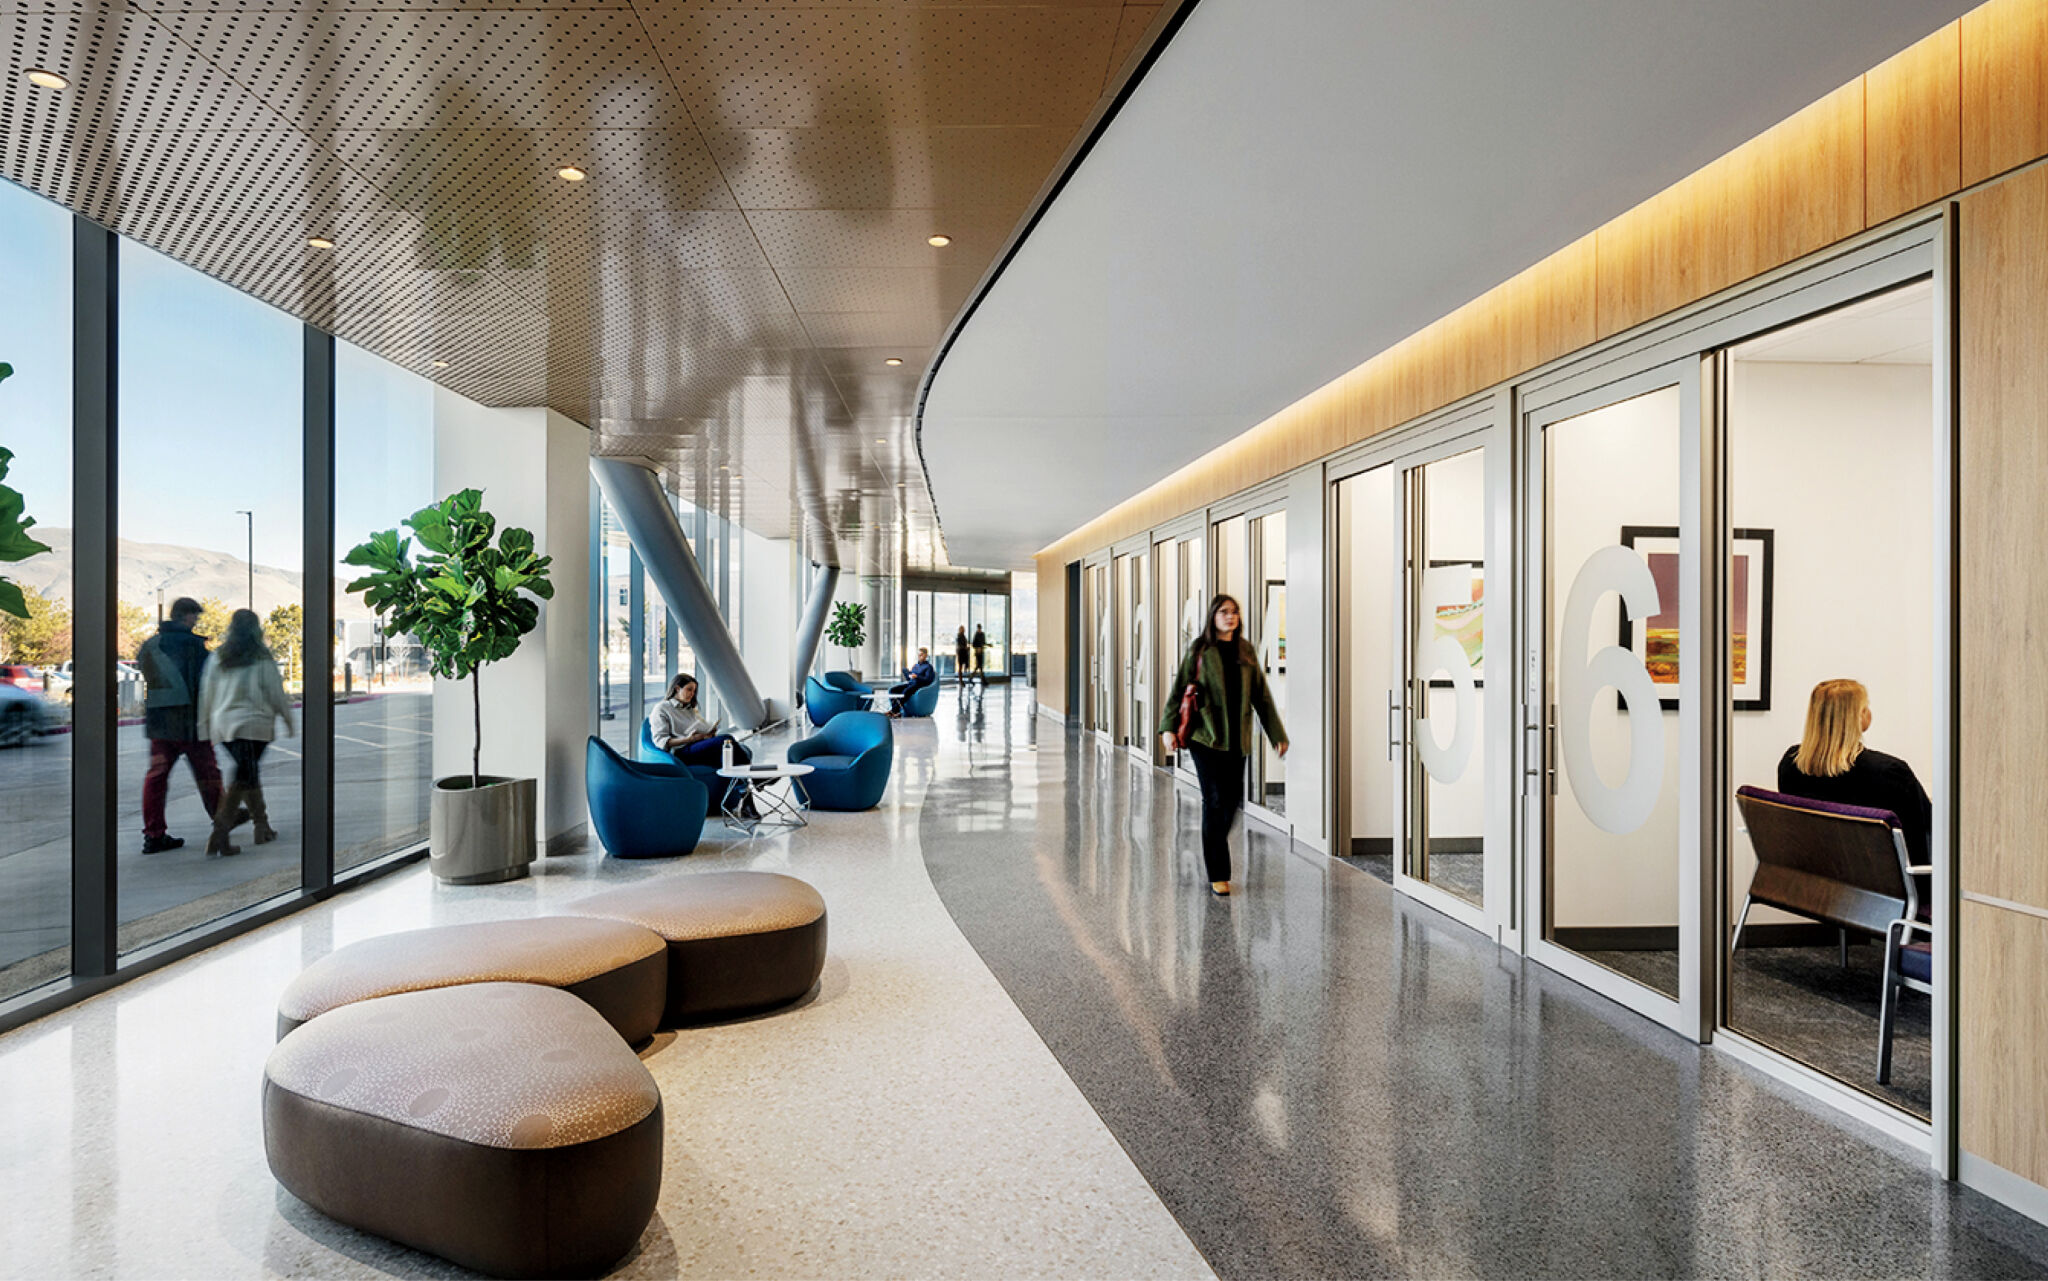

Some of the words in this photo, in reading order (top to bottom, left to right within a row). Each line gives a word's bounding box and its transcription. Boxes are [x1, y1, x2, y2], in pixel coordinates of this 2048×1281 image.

[1135, 603, 1147, 702] 2
[1415, 563, 1476, 785] 5
[1559, 545, 1665, 835] 6
